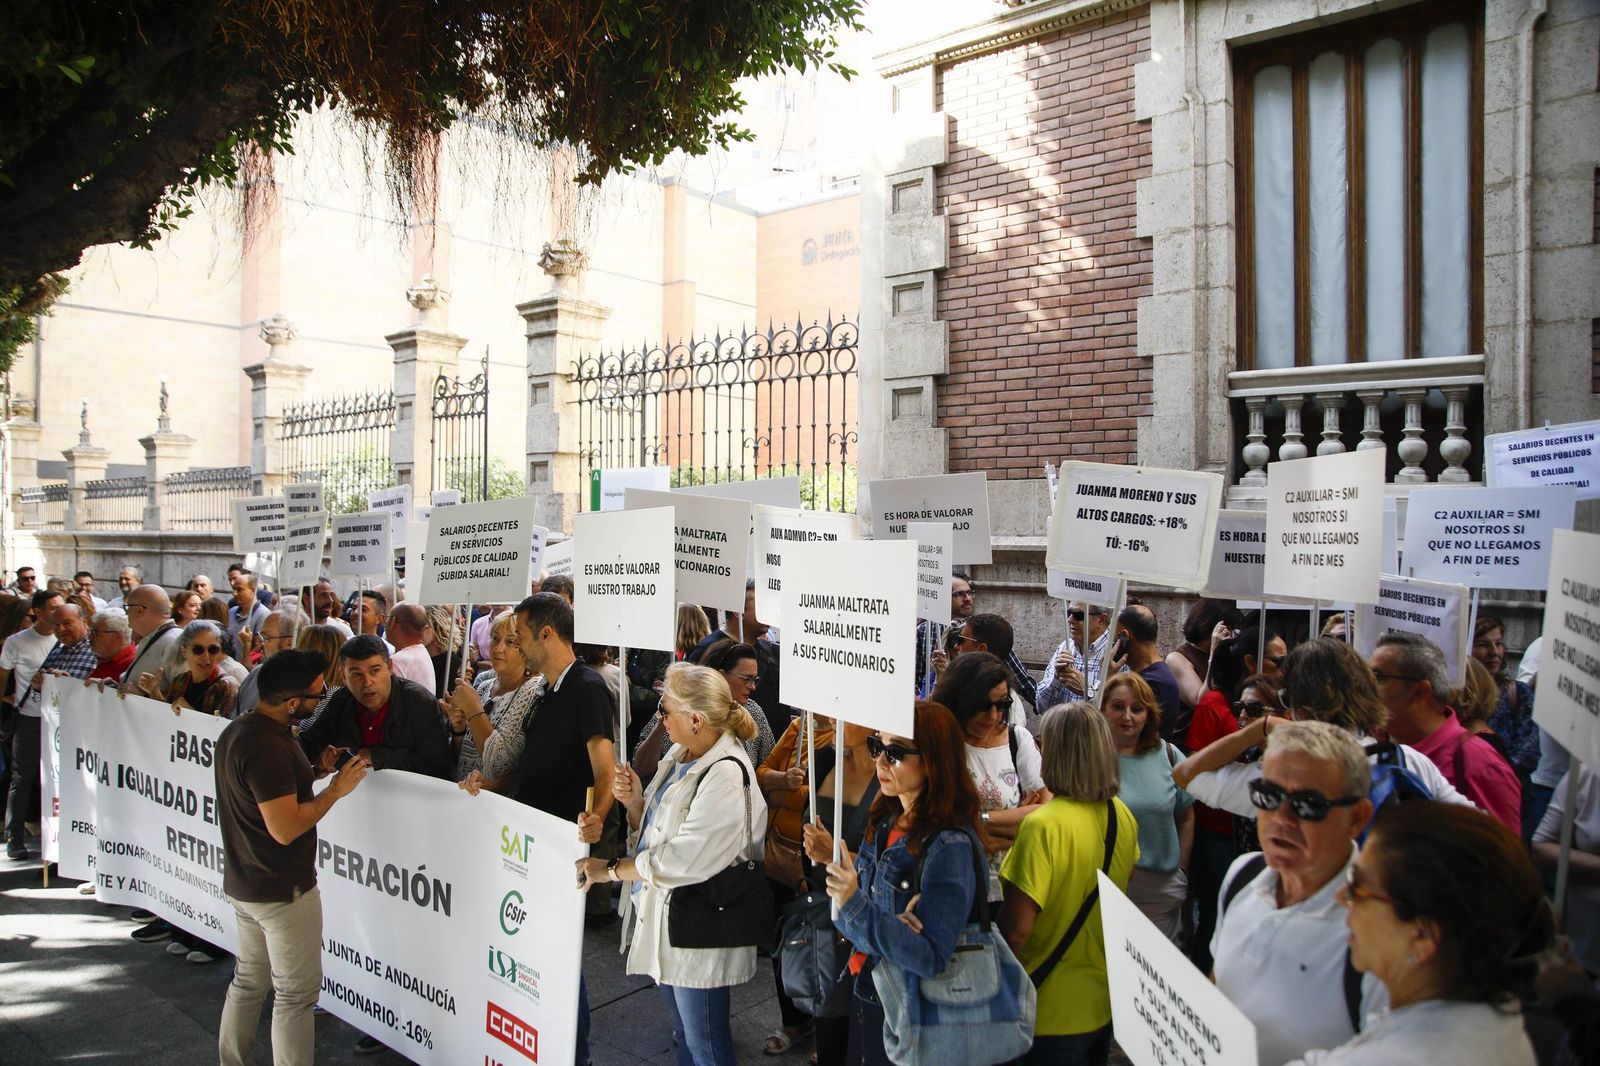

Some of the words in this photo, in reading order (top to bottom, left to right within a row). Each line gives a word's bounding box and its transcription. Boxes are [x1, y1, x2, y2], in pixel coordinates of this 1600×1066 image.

[1508, 441, 1543, 451] SALARIOS
[1545, 435, 1582, 446] DECENTES
[1512, 453, 1551, 465] SERVICIOS
[593, 472, 599, 480] A
[1542, 466, 1574, 476] CALIDAD
[1076, 484, 1117, 498] JUANMA
[1119, 488, 1163, 502] MORENO
[1165, 492, 1172, 503] Y
[1175, 492, 1197, 505] SUS
[1285, 492, 1295, 503] C2
[1296, 489, 1333, 502] AUXILIAR
[1342, 487, 1358, 499] SMI
[896, 511, 919, 520] HORA
[921, 510, 932, 518] DE
[934, 508, 973, 518] VALORAR
[1077, 508, 1108, 522] ALTOS
[1111, 511, 1155, 527] CARGOS:
[1159, 517, 1187, 529] +18%
[1293, 511, 1337, 523] NOSOTROS
[1339, 510, 1348, 522] SI
[1434, 511, 1448, 519] C2
[1450, 510, 1504, 519] AUXILIAR
[1517, 510, 1540, 519] SMI
[440, 524, 476, 536] SALARIOS
[477, 520, 519, 532] DECENTES
[681, 527, 727, 542] MALTRATA
[771, 528, 783, 540] AUX
[889, 525, 907, 533] NUE
[953, 522, 970, 530] AJO
[1445, 525, 1510, 534] NOSOTROS
[1513, 525, 1525, 534] SI
[451, 541, 460, 550] EN
[462, 537, 503, 549] SERVICIOS
[1106, 536, 1121, 549] TÚ:
[1124, 539, 1149, 552] -16%
[1220, 531, 1230, 541] ES
[1233, 531, 1259, 542] HORA
[1282, 533, 1297, 546] QUE
[1300, 533, 1310, 544] NO
[1313, 532, 1359, 545] LLEGAMOS
[1428, 540, 1451, 551] QUE
[1454, 541, 1471, 549] NO
[1475, 541, 1541, 550] LLEGAMOS
[434, 555, 470, 566] PÚBLICOS
[472, 554, 482, 563] DE
[484, 551, 518, 562] CALIDAD
[1292, 554, 1296, 564] A
[1299, 554, 1311, 565] FIN
[1314, 554, 1324, 566] DE
[1326, 554, 1344, 567] MES
[1443, 555, 1450, 564] A
[1453, 555, 1472, 564] FIN
[1475, 556, 1491, 564] DE
[1494, 556, 1520, 565] MES
[437, 570, 468, 583] ¡SUBIDA
[470, 567, 510, 579] SALARIAL!
[585, 564, 592, 575] ES
[594, 564, 613, 575] HORA
[615, 564, 624, 574] DE
[626, 563, 660, 574] VALORAR
[588, 584, 620, 595] NUESTRO
[622, 584, 656, 595] TRABAJO
[1065, 578, 1102, 592] FUNCIONARIO
[799, 593, 835, 610] JUANMA
[838, 596, 889, 615] MALTRATA
[1403, 592, 1436, 606] DECENTES
[1437, 598, 1446, 607] EN
[1374, 606, 1407, 620] SERVICIOS
[1408, 612, 1440, 627] PÚBLICOS
[804, 619, 881, 643] SALARIALMENTE
[793, 643, 798, 657] A
[800, 644, 816, 660] SUS
[819, 647, 894, 674] FUNCIONARIOS
[117, 764, 198, 816] IGUALDAD
[153, 854, 162, 870] DE
[318, 838, 452, 917] PERACIÓN
[116, 876, 126, 889] Y
[130, 878, 158, 899] ALTOS
[159, 890, 196, 920] CARGOS:
[198, 911, 224, 933] +18%
[505, 902, 527, 925] CSIF
[329, 939, 362, 969] JUNTA
[366, 955, 382, 978] DE
[385, 965, 456, 1016] ANDALUCÍA
[1125, 939, 1166, 994] JUANMA
[1168, 985, 1221, 1054] MORENO
[490, 1010, 535, 1055] CCOO
[1148, 988, 1168, 1022] SUS
[1171, 1016, 1206, 1066] ALTOS
[402, 1020, 432, 1050] -16%
